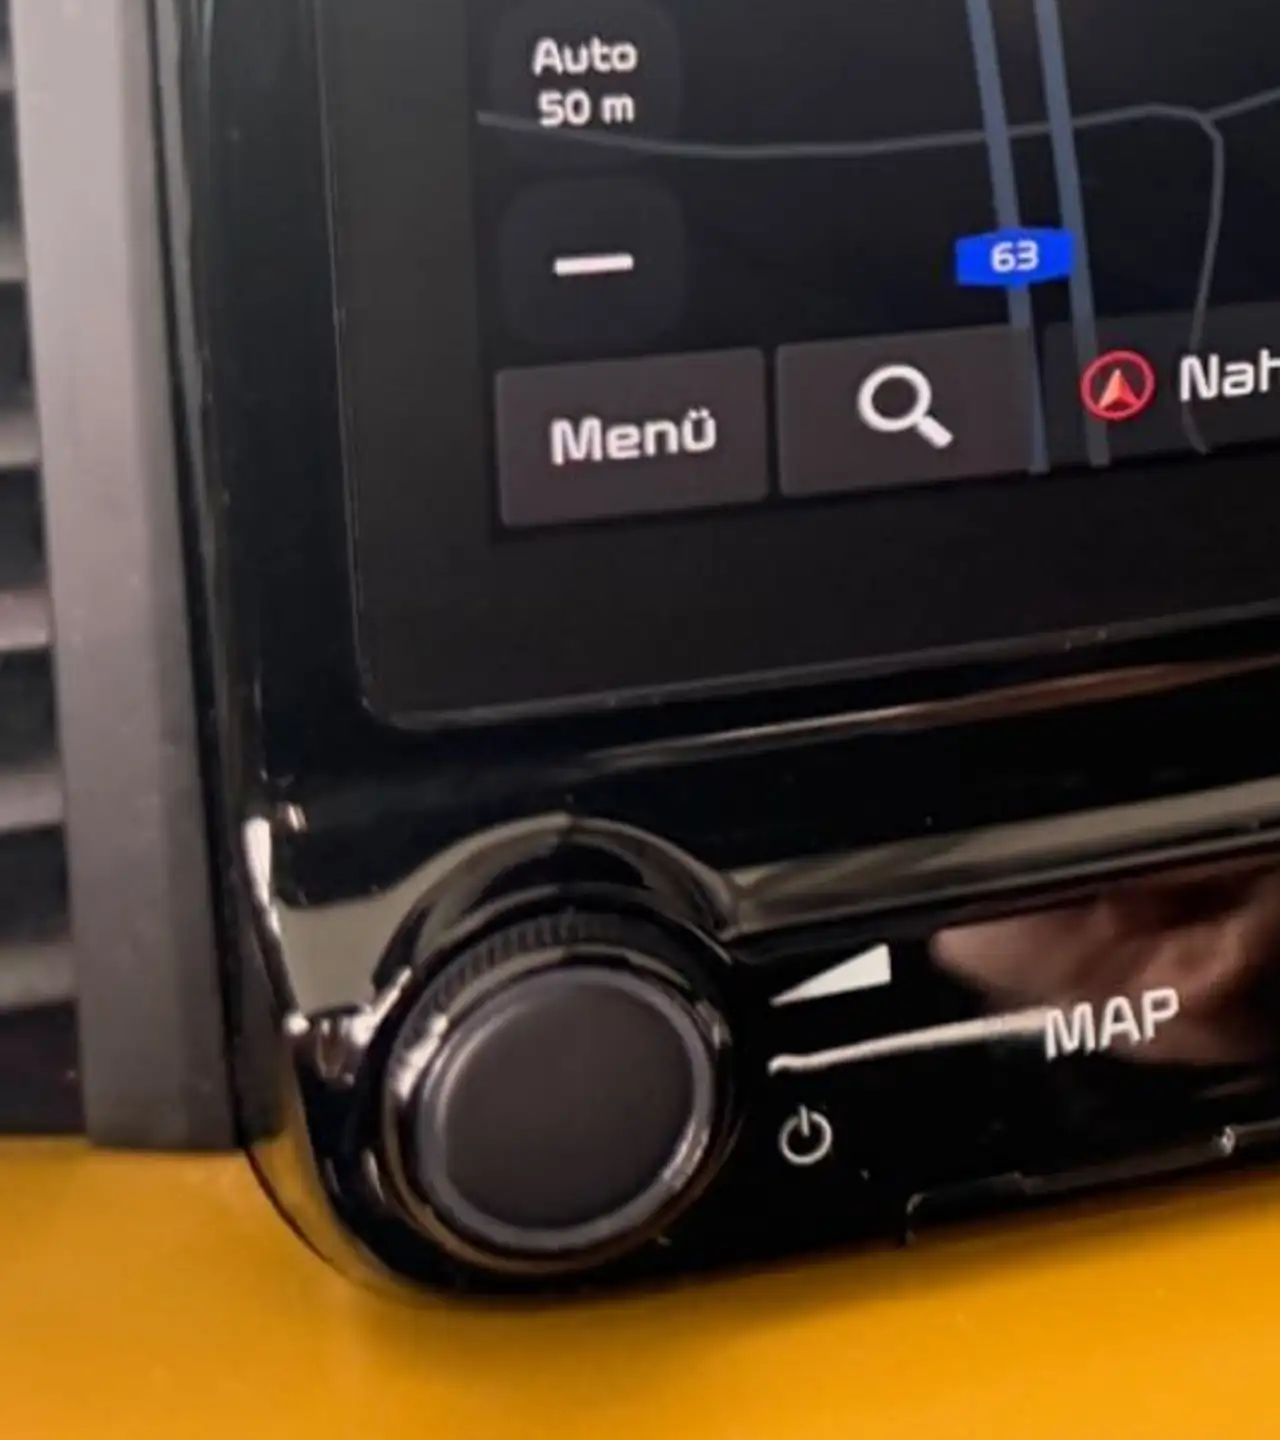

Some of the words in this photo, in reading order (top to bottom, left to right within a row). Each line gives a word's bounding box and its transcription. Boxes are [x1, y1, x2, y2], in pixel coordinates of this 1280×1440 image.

[532, 37, 638, 77] Auto
[538, 90, 592, 127] 50
[602, 95, 635, 123] m
[991, 240, 1040, 272] 63
[549, 408, 718, 466] Menü
[1043, 986, 1181, 1062] MAP
